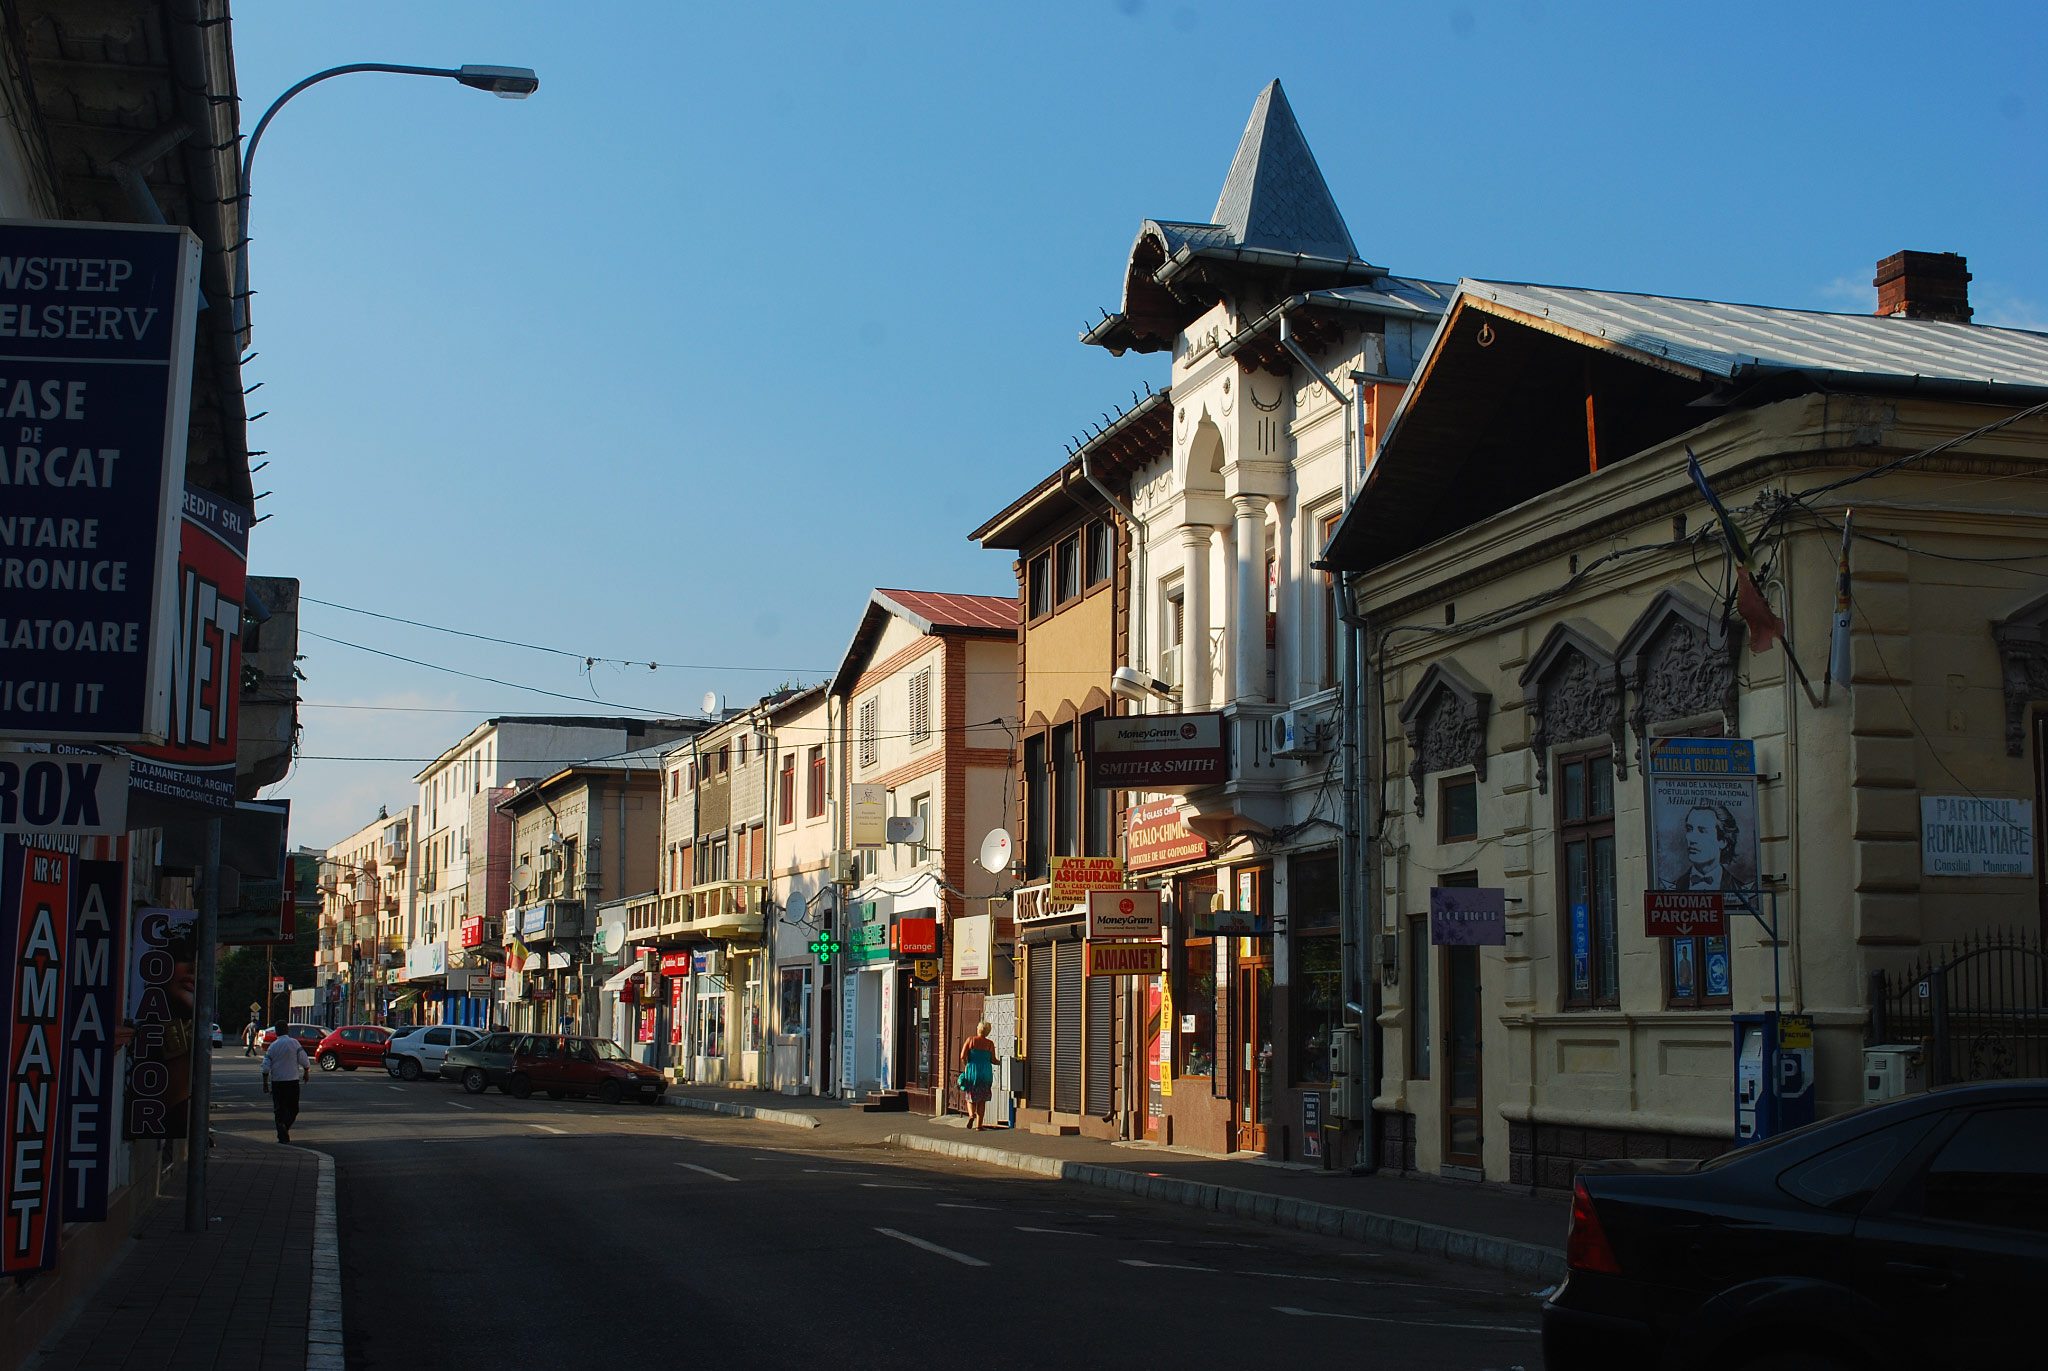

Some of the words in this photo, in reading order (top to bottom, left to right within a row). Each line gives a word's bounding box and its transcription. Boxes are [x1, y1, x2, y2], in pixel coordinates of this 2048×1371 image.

[0, 304, 159, 341] ELSERV
[21, 426, 44, 444] DE
[0, 516, 100, 549] NTARE
[221, 509, 245, 535] SRL
[0, 558, 128, 592] RONICE
[0, 680, 61, 713] ICII
[74, 682, 105, 714] IT
[1117, 728, 1179, 742] MoneyGram
[1098, 759, 1215, 776] SMITH&SMITH
[1654, 757, 1692, 772] FILIALA
[1694, 758, 1729, 772] BUZAU
[137, 761, 149, 777] LA
[204, 779, 236, 797] ARGINT,
[1677, 781, 1688, 789] ANI
[1658, 788, 1690, 796] POETULUI
[1691, 789, 1717, 797] NOSTRU
[1667, 797, 1697, 806] Mihail
[1936, 799, 2016, 823] PARTIDUL
[1926, 824, 1987, 854] ROMANIA
[1989, 825, 2029, 856] MARE
[34, 856, 48, 881] NR
[50, 858, 62, 883] 14
[1062, 859, 1086, 868] ACTE
[1089, 860, 1114, 869] AUTO
[1934, 858, 1971, 873] Consiliul
[1054, 870, 1122, 883] ASIGURARI
[1017, 889, 1040, 920] RBK
[1654, 895, 1714, 908] AUTOMAT
[1097, 915, 1154, 926] MoneyGram
[1651, 910, 1718, 923] PARCARE
[903, 943, 933, 953] orange
[1094, 948, 1158, 971] AMANET
[1920, 983, 1928, 996] 21
[1163, 977, 1172, 1029] AMANET
[131, 912, 176, 1136] COAFOR
[68, 883, 112, 1209] AMANET
[11, 908, 60, 1252] AMANET
[1780, 1059, 1798, 1086] P
